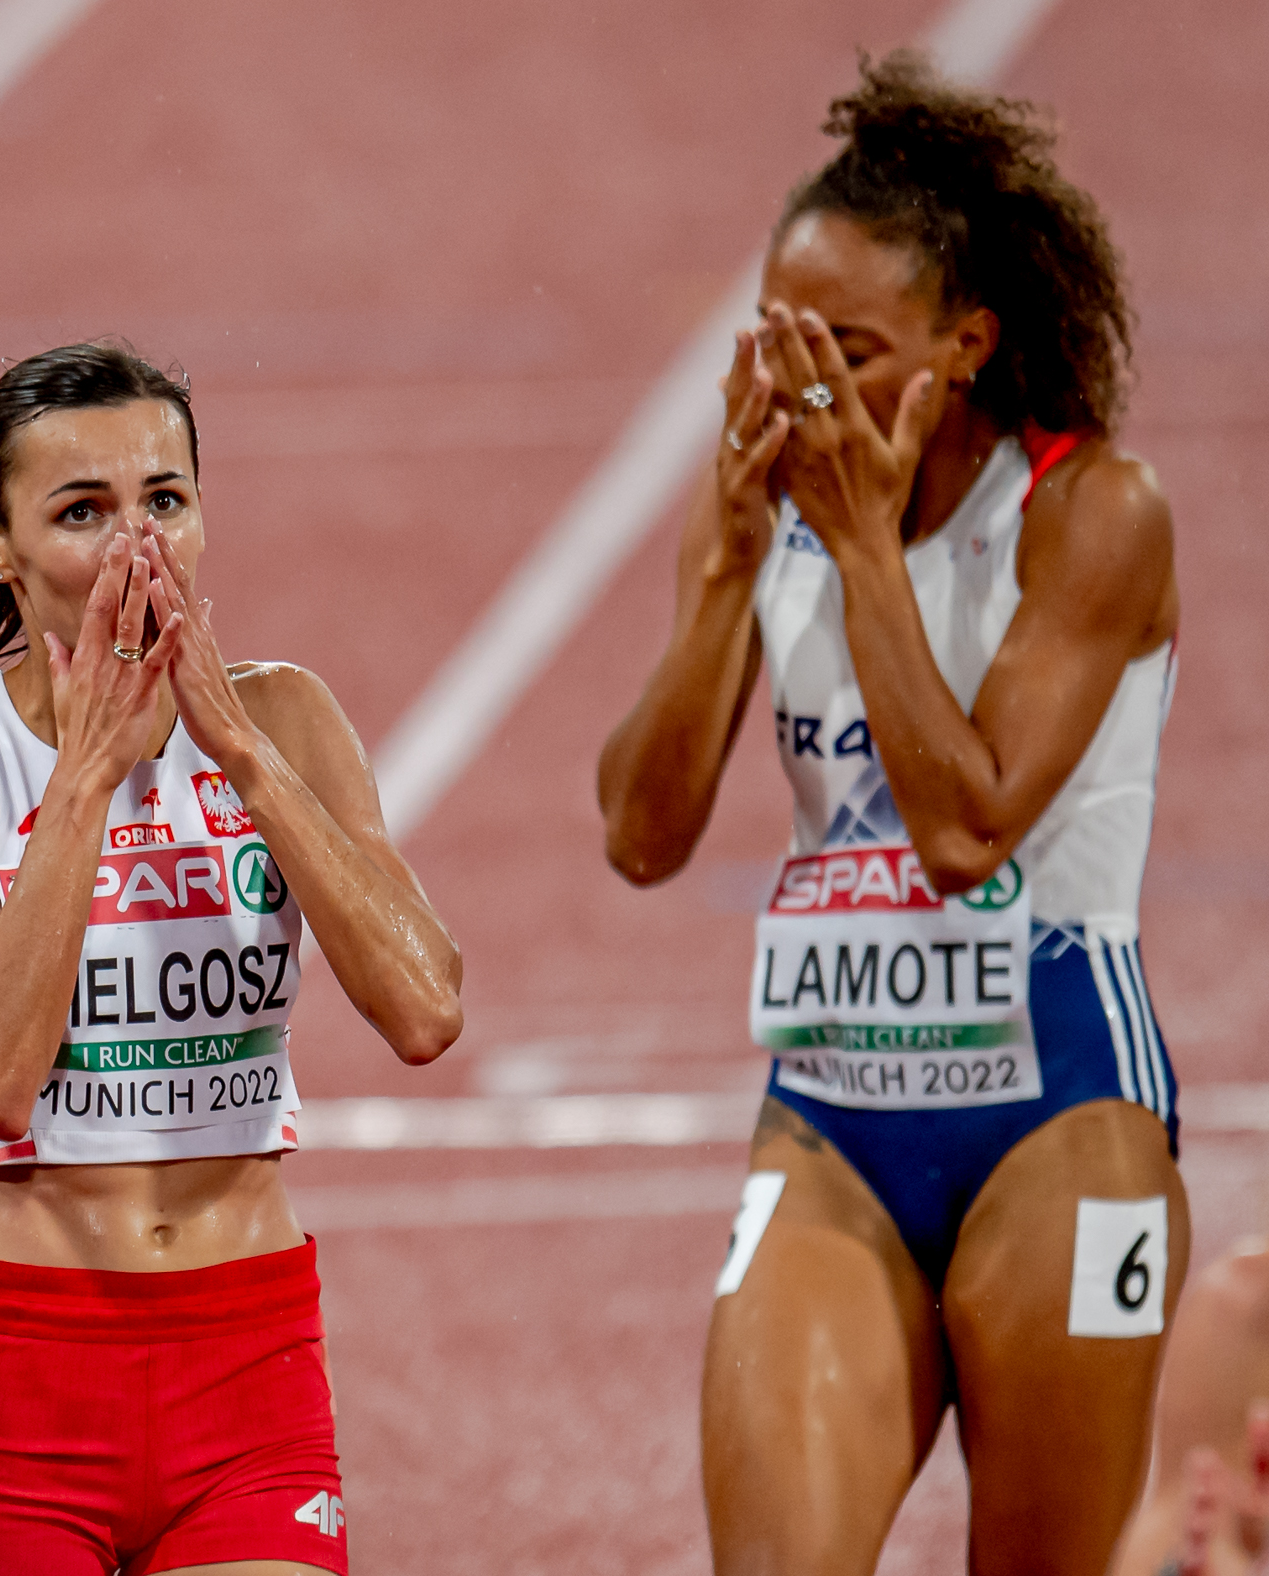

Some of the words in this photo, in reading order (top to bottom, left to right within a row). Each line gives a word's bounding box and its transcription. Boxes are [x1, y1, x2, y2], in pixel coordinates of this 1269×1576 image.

[8, 856, 225, 913] PAR
[776, 853, 940, 910] SPAR
[761, 941, 1015, 1008] LAMOTE
[83, 1046, 89, 1068] I
[99, 1044, 155, 1069] RUN
[920, 1055, 1022, 1097] 2022
[208, 1065, 283, 1112] 2022
[1112, 1228, 1151, 1315] 6
